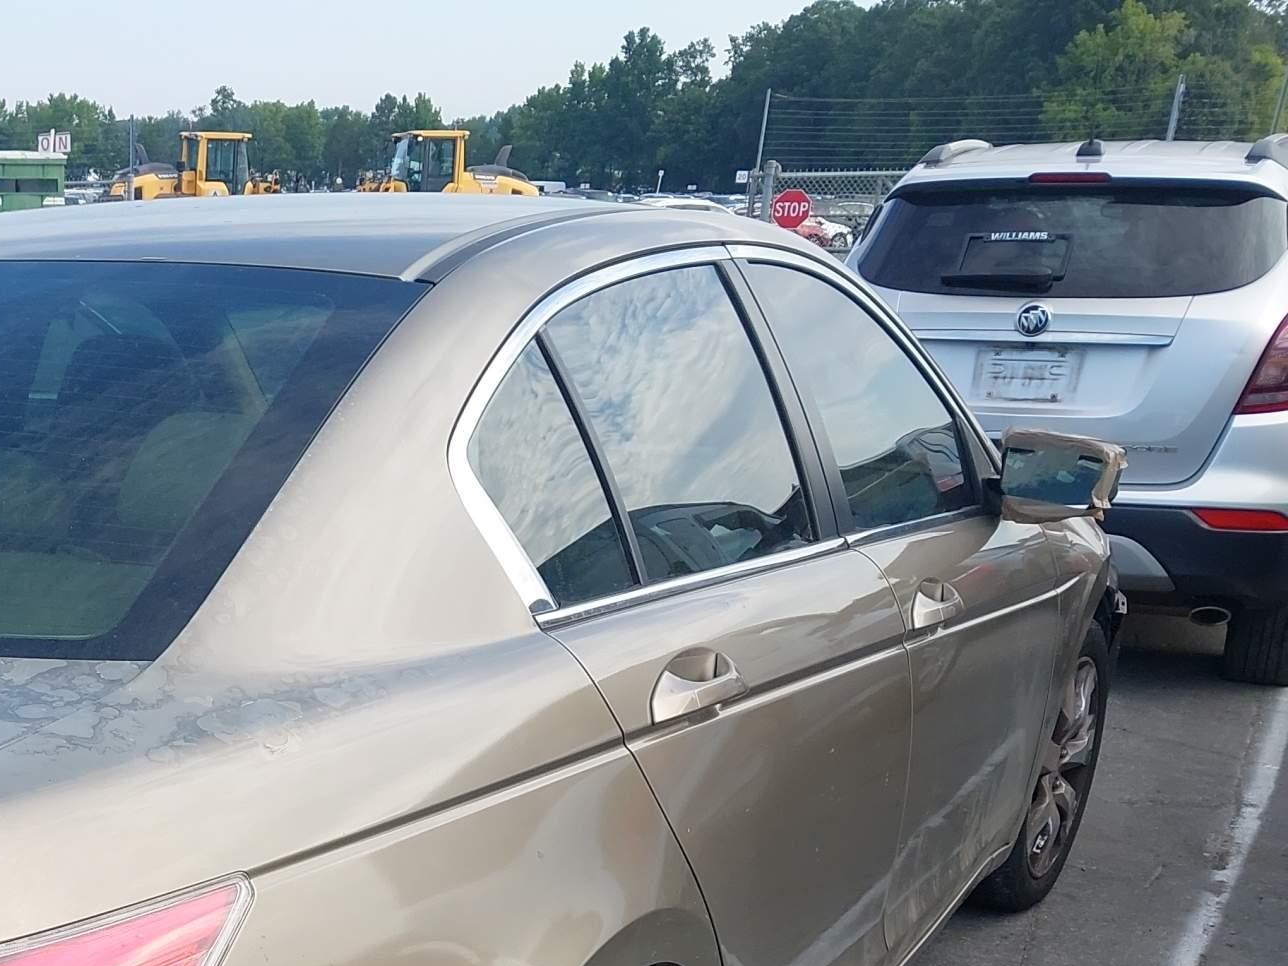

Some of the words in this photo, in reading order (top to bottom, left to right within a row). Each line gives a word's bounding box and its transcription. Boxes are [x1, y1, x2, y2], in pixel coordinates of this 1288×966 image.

[58, 136, 68, 150] N
[774, 202, 809, 217] STOP
[990, 231, 1049, 241] WILLIAMS
